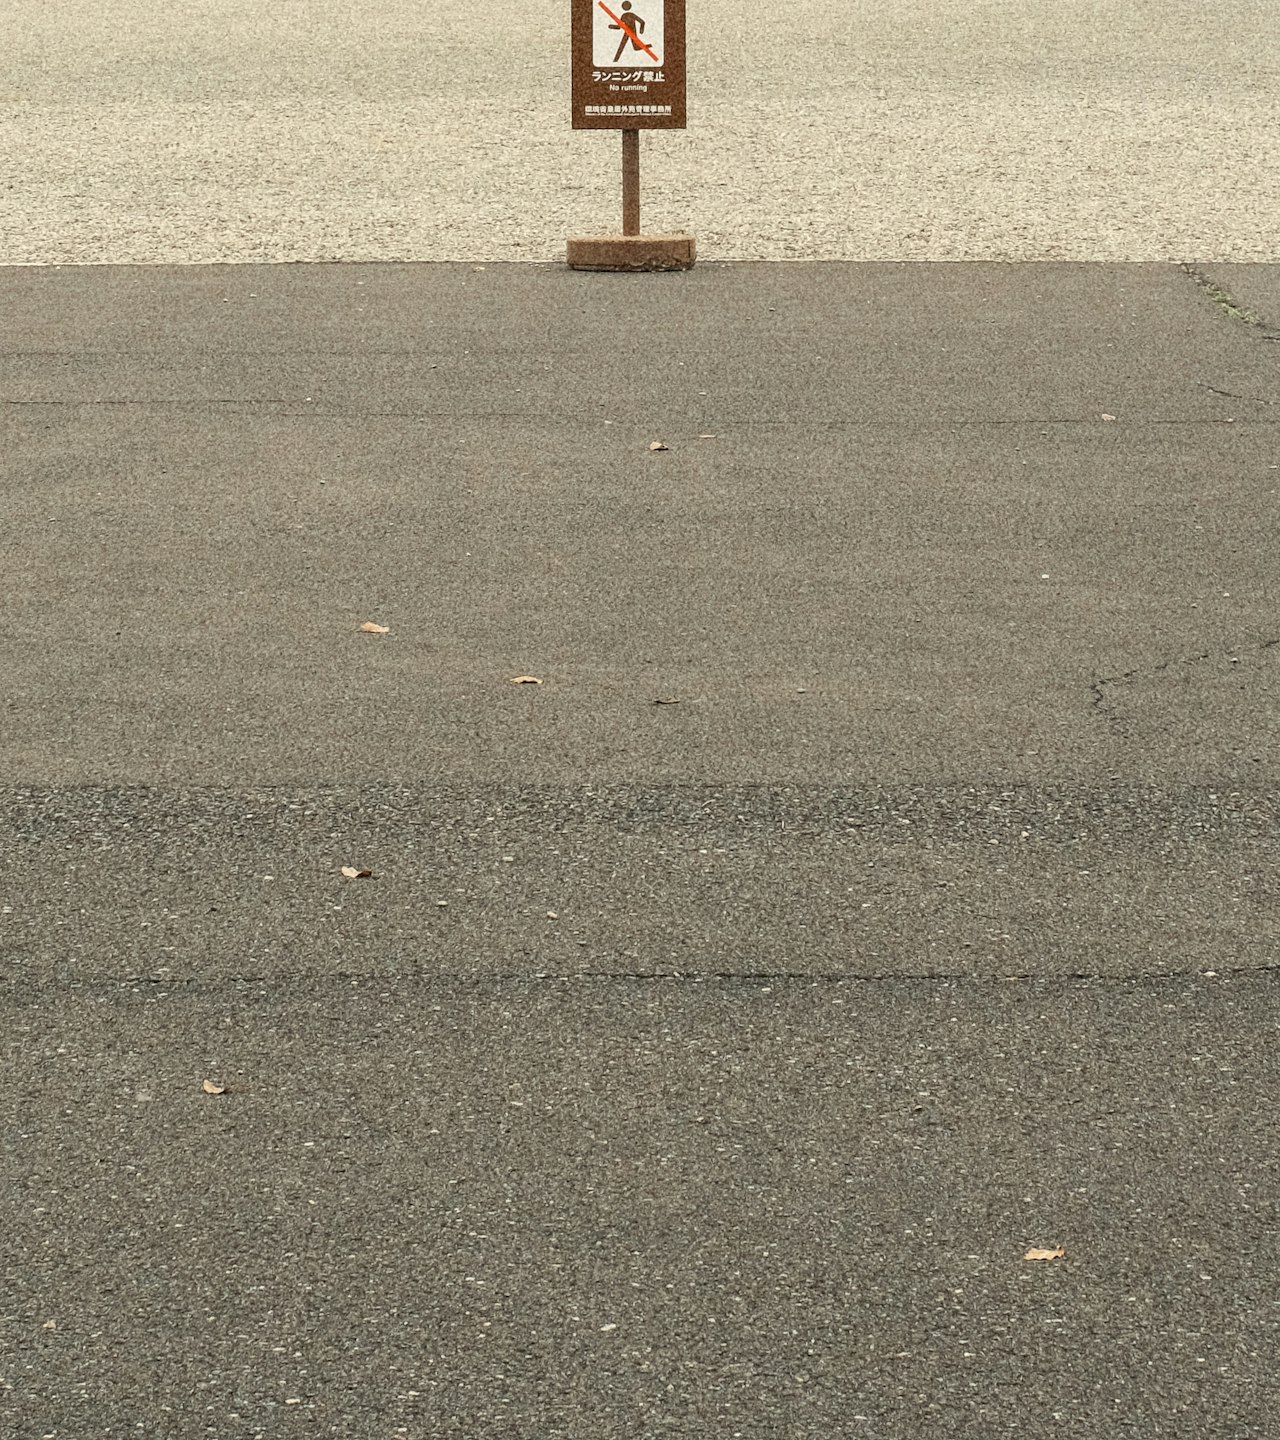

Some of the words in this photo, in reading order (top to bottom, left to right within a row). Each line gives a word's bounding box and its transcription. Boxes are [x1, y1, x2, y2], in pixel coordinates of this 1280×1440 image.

[591, 70, 666, 83] ランニング禁止
[609, 83, 620, 92] No
[621, 83, 648, 93] running
